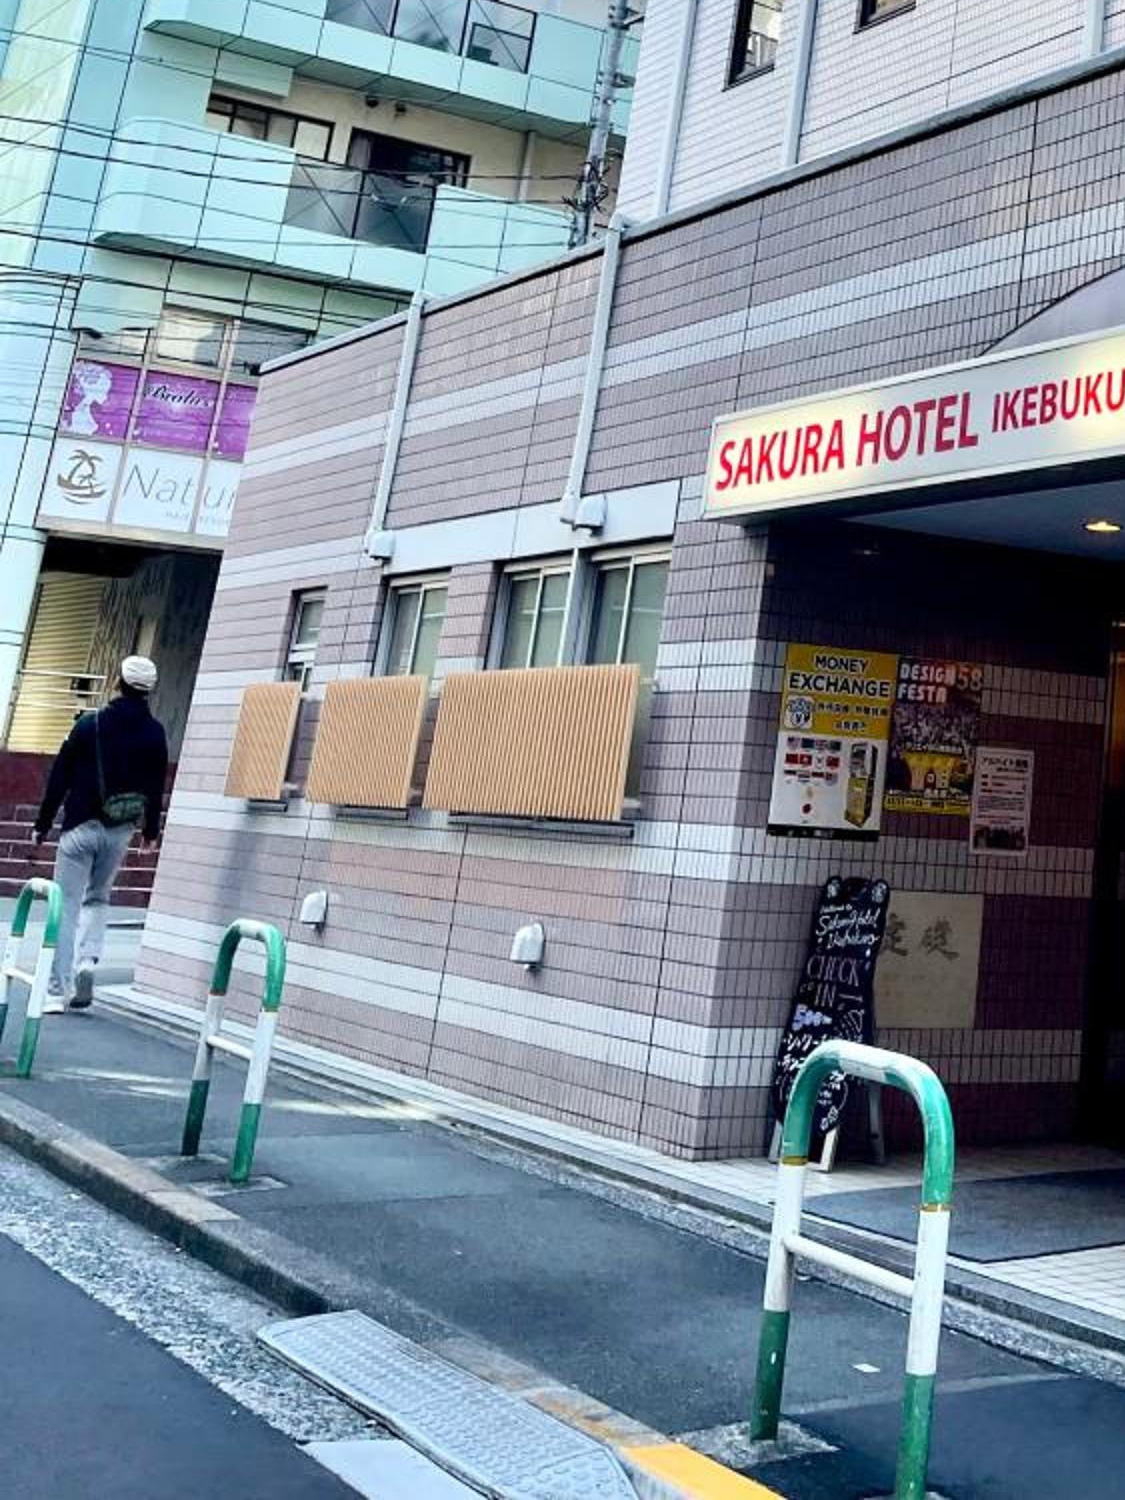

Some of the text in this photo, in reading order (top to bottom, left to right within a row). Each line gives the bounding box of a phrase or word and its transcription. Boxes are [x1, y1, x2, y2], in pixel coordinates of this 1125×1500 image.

[714, 418, 845, 491] SAKURA
[856, 392, 980, 468] HOTEL
[814, 654, 870, 673] MONEY
[899, 662, 983, 692] DESIGN 58
[788, 674, 891, 697] EXCHANGE
[807, 955, 860, 988] CHECK
